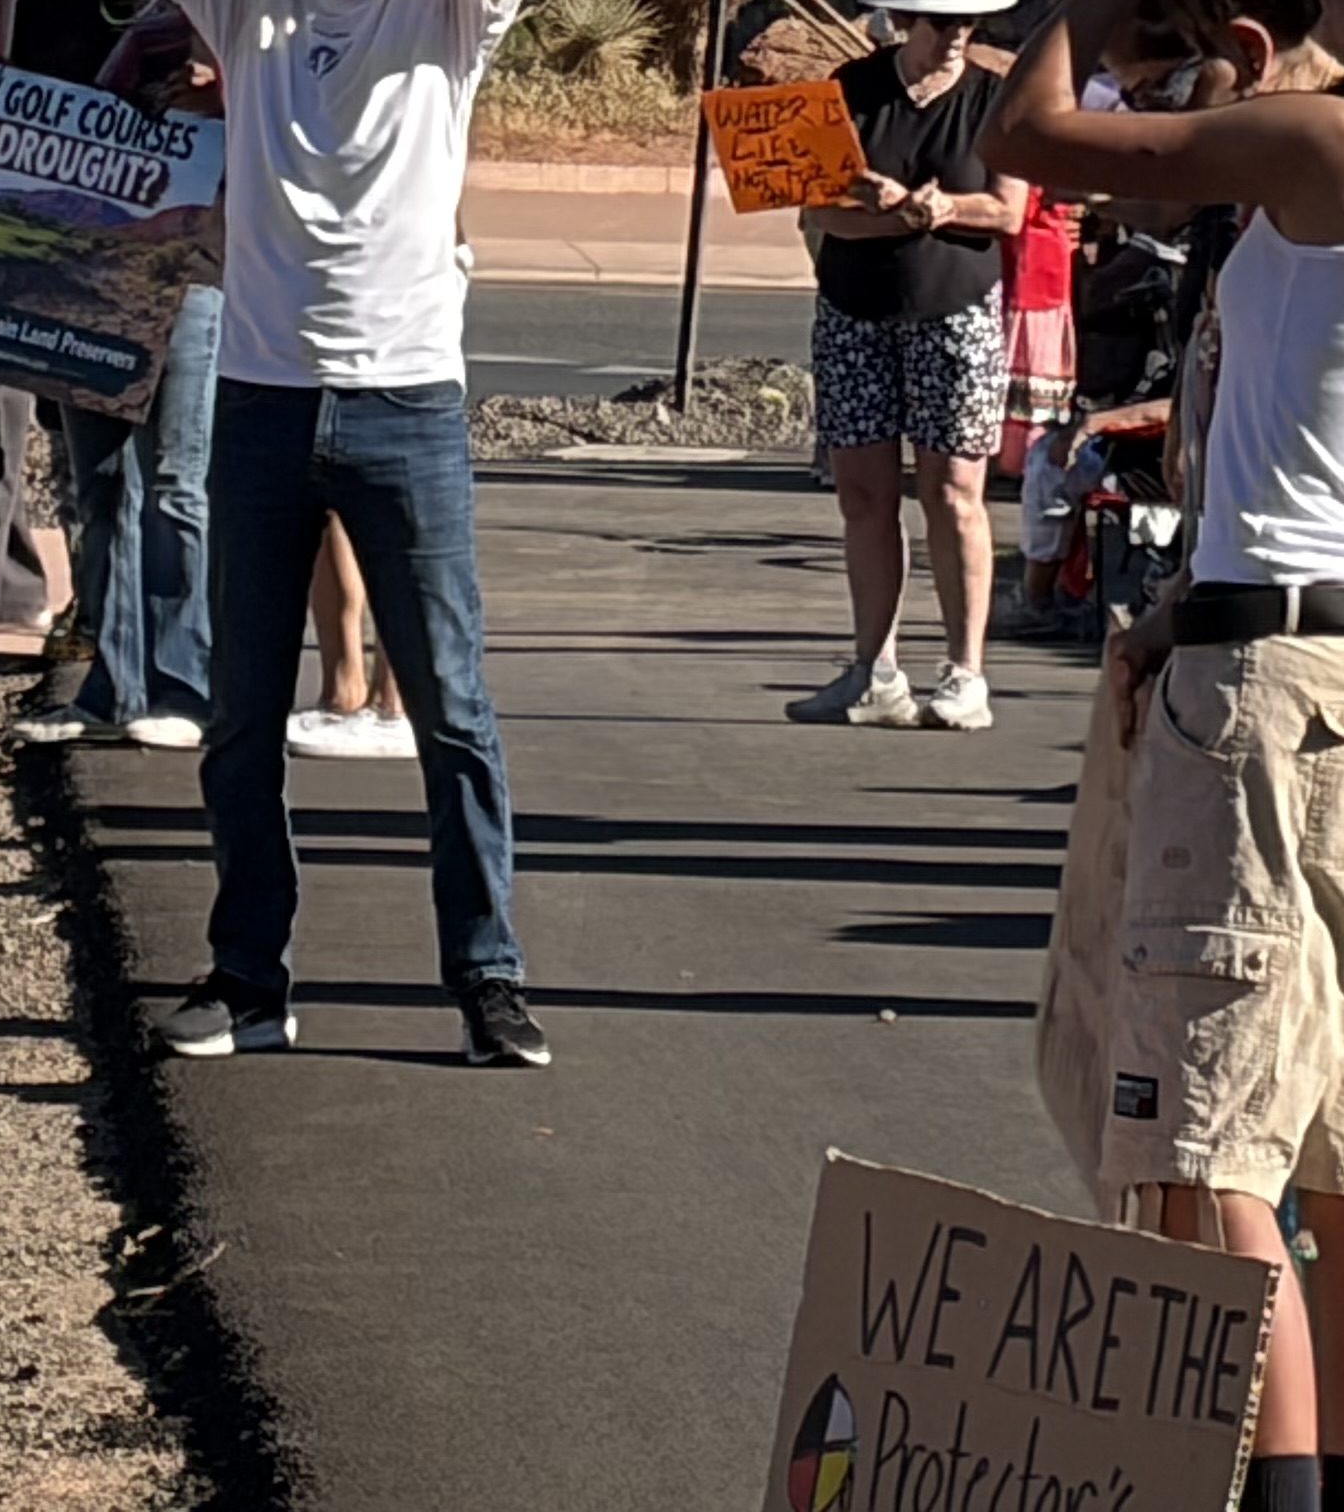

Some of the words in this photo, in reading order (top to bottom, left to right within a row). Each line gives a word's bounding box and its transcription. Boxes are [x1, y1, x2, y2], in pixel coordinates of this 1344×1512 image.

[5, 80, 76, 128] GOLF
[77, 99, 199, 160] COURSES
[19, 320, 61, 351] Land
[57, 330, 137, 371] Preservers
[860, 1210, 987, 1369] WE
[986, 1243, 1138, 1411] ARE
[1145, 1284, 1248, 1426] THE
